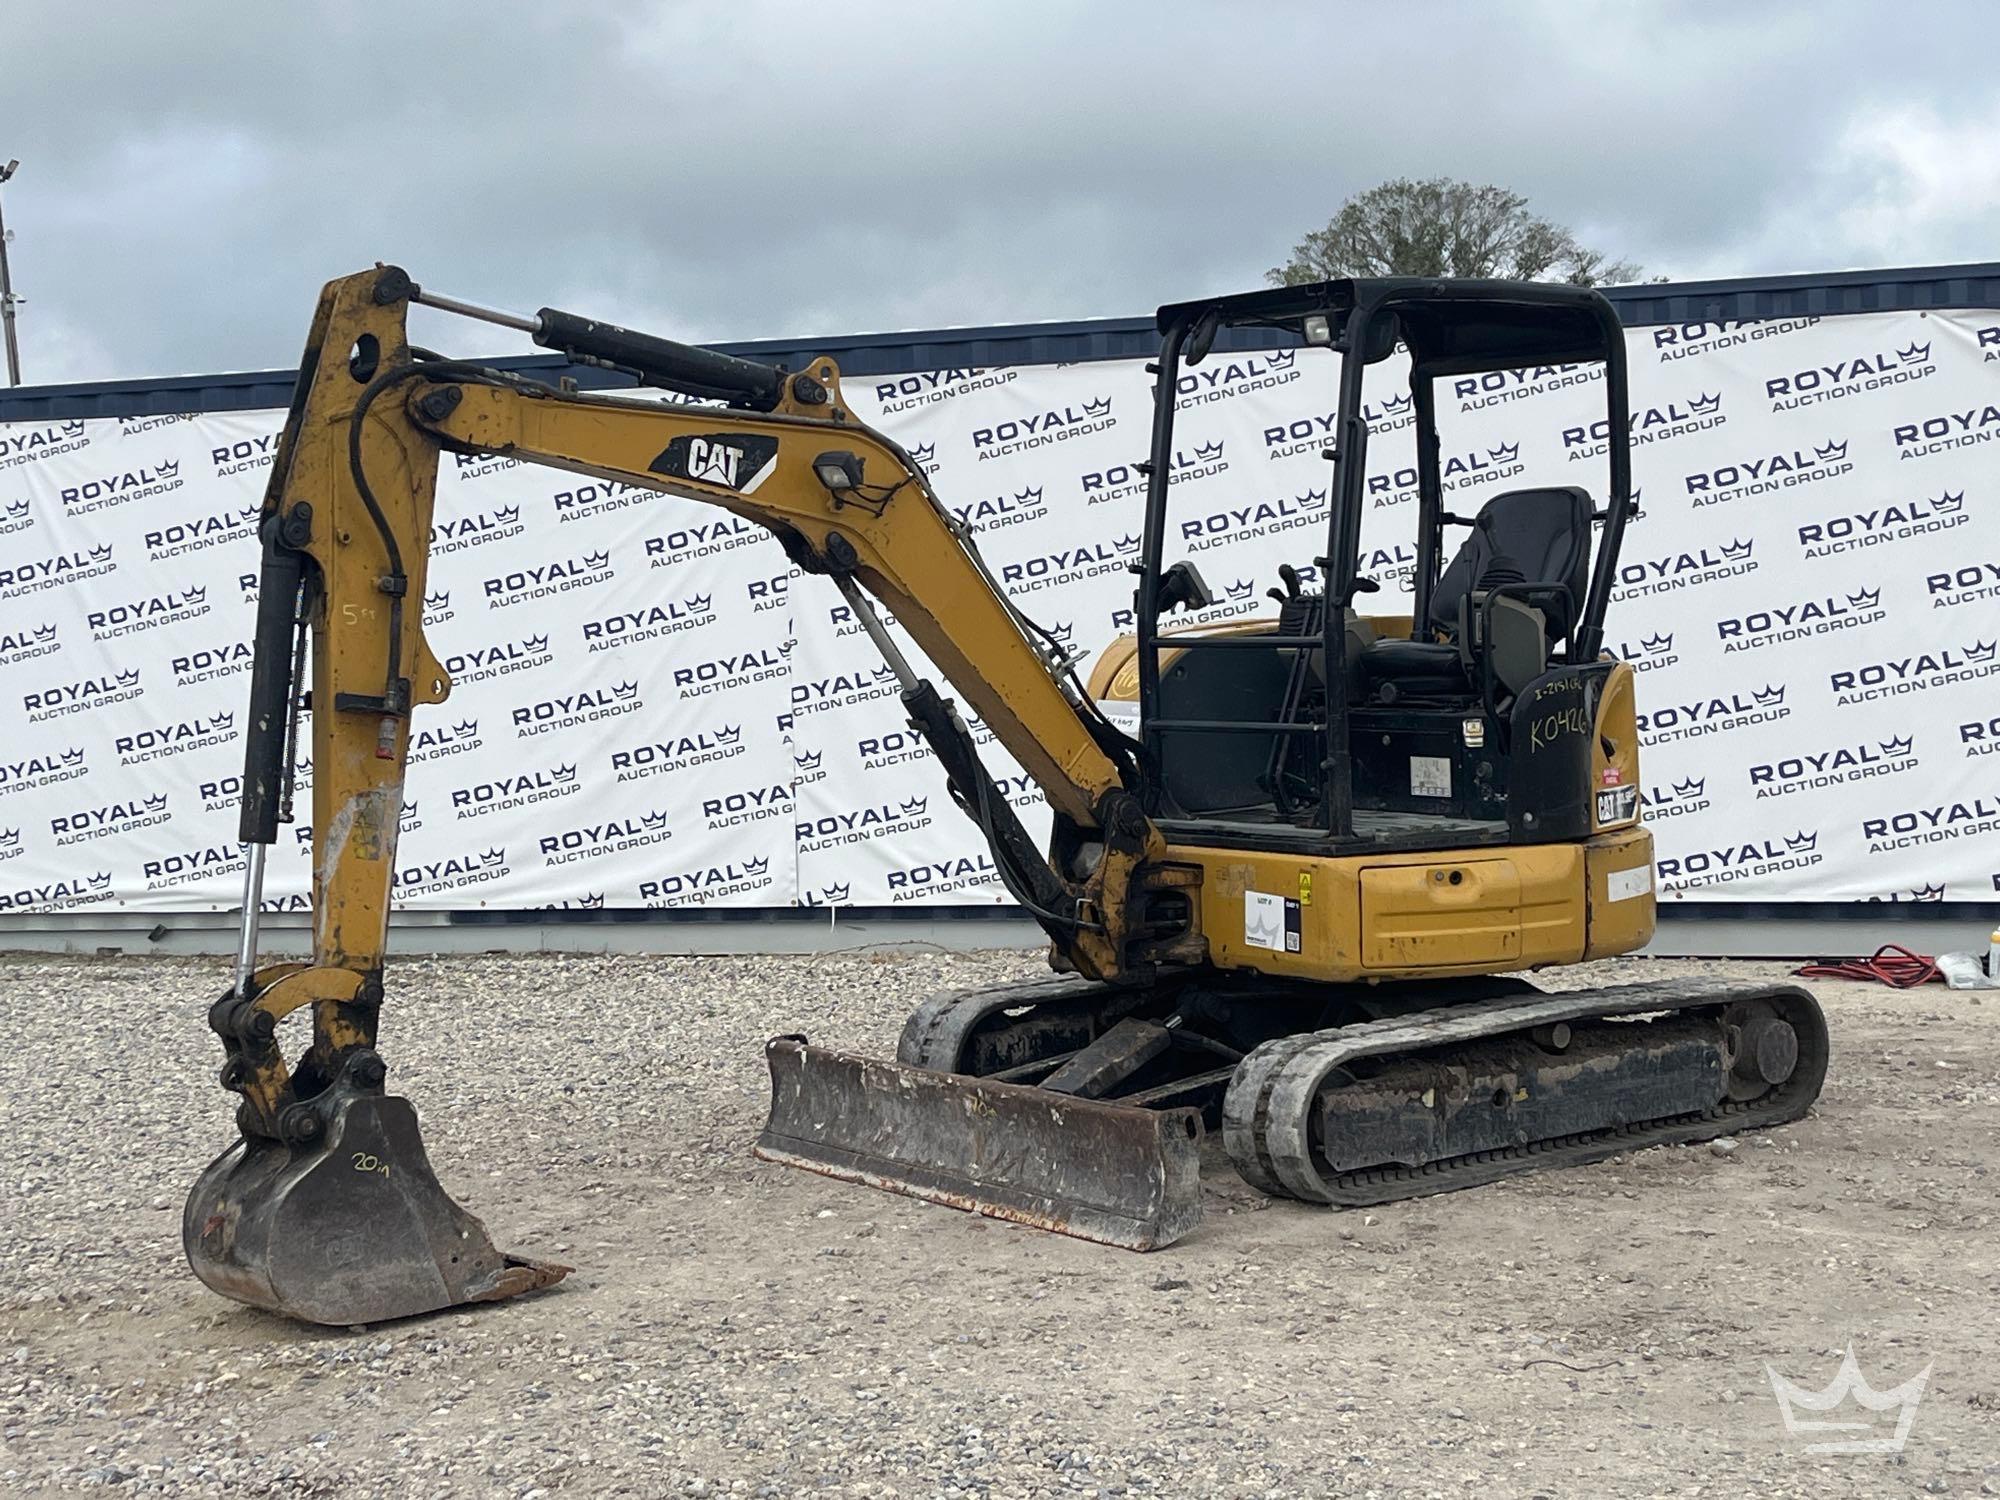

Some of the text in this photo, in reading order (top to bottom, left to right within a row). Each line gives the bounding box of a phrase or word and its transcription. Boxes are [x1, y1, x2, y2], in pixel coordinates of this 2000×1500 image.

[1660, 315, 1821, 363] AUCTION GROUP
[882, 372, 1018, 415] AUCTION GROUP
[1238, 371, 1301, 395] GROUP
[1766, 353, 1898, 398] ROYAL
[1773, 365, 1937, 412] AUCTION GROUP
[1461, 383, 1544, 412] AUCTION
[972, 408, 1084, 448] ROYAL
[978, 418, 1117, 461] AUCTION GROUP
[1658, 416, 1727, 440] GROUP
[1901, 430, 1991, 460] AUCTION
[39, 438, 90, 459] GROUP
[688, 438, 744, 486] CAT
[1270, 436, 1335, 460] AUCTIO
[61, 469, 156, 505] ROYAL
[1087, 463, 1229, 505] AUCTIO GROUP
[1459, 464, 1525, 488] GROUP
[1686, 451, 1815, 494] ROYAL
[1692, 463, 1853, 508] AUCTION GROUP
[67, 479, 183, 517] AUCTION GROUP
[560, 498, 629, 523] AUCTION
[145, 513, 241, 549] ROYAL
[470, 525, 524, 546] GROUP
[646, 518, 750, 556] ROYAL
[988, 508, 1047, 530] GROUP
[1181, 499, 1298, 540] ROYAL
[1187, 511, 1332, 553] AUCTION GROUP
[1799, 502, 1931, 545] ROYAL
[1805, 514, 1970, 559] AUCTION GROUP
[151, 525, 259, 561] AUCTION GROU
[651, 544, 721, 569] AUCTION
[0, 552, 90, 588] ROYAL
[2, 563, 117, 600] AUCTION GROUP
[484, 560, 585, 597] ROYAL
[1002, 544, 1114, 583] ROYAL
[1690, 562, 1759, 585] GROUP
[489, 571, 615, 609] AUCTION GROUP
[1008, 570, 1083, 596] AUCTION
[89, 594, 183, 630] ROYAL
[94, 605, 211, 642] AUCTION GROUP
[343, 603, 360, 625] 5
[583, 603, 686, 640] ROYAL
[1197, 601, 1259, 623] GROUP
[1718, 598, 1848, 640] ROYAL
[589, 615, 716, 653] AUCTION GROUP
[1724, 611, 1886, 654] AUCTION GROUP
[11, 643, 61, 663] GROUP
[173, 642, 253, 674] ROYA
[445, 643, 523, 674] OYAL
[498, 654, 553, 675] GROUP
[674, 650, 779, 687] ROYAL
[178, 663, 243, 686] AUCTION
[680, 675, 750, 699] AUCTION
[1831, 651, 1964, 692] ROYAL
[24, 677, 117, 712] ROYAL
[29, 688, 145, 723] AUCTION GROUP
[512, 689, 614, 726] ROYAL
[1838, 679, 1927, 706] AUCTION
[116, 719, 211, 754] ROYAL
[518, 701, 643, 738] AUCTION GROUP
[1722, 708, 1791, 730] GROUP
[121, 731, 239, 766] AUCTION GROUP
[428, 739, 482, 759] GROUP
[612, 734, 715, 770] ROYAL
[618, 746, 745, 782] AUCTION GROUP
[1750, 745, 1880, 785] ROYAL
[38, 767, 88, 787] GROUP
[451, 772, 552, 807] ROYAL
[1756, 759, 1919, 799] AUCTION GROUP
[51, 801, 144, 835] ROYAL
[457, 784, 581, 820] AUCTION GROUP
[709, 806, 779, 830] AUCTION
[1642, 800, 1711, 822] GROUP
[1864, 799, 1997, 839] ROYAL
[56, 813, 172, 847] AUCTION GROUP
[541, 819, 642, 854] ROYAL
[795, 805, 900, 841] ROYAL
[800, 817, 932, 853] AUCTION GROUP
[1870, 827, 1959, 853] AUCTION
[143, 845, 238, 879] ROYAL
[546, 831, 672, 867] AUCTION GROUP
[1658, 840, 1786, 879] ROYAL
[149, 869, 212, 891] AUCTION
[456, 868, 510, 887] GROUP
[641, 865, 744, 900] ROYAL
[718, 877, 774, 897] GROUP
[888, 854, 996, 890] ROYAL
[1664, 854, 1823, 893] AUCTION GROUP
[65, 892, 115, 910] GROUP
[894, 879, 966, 902] AUCTION
